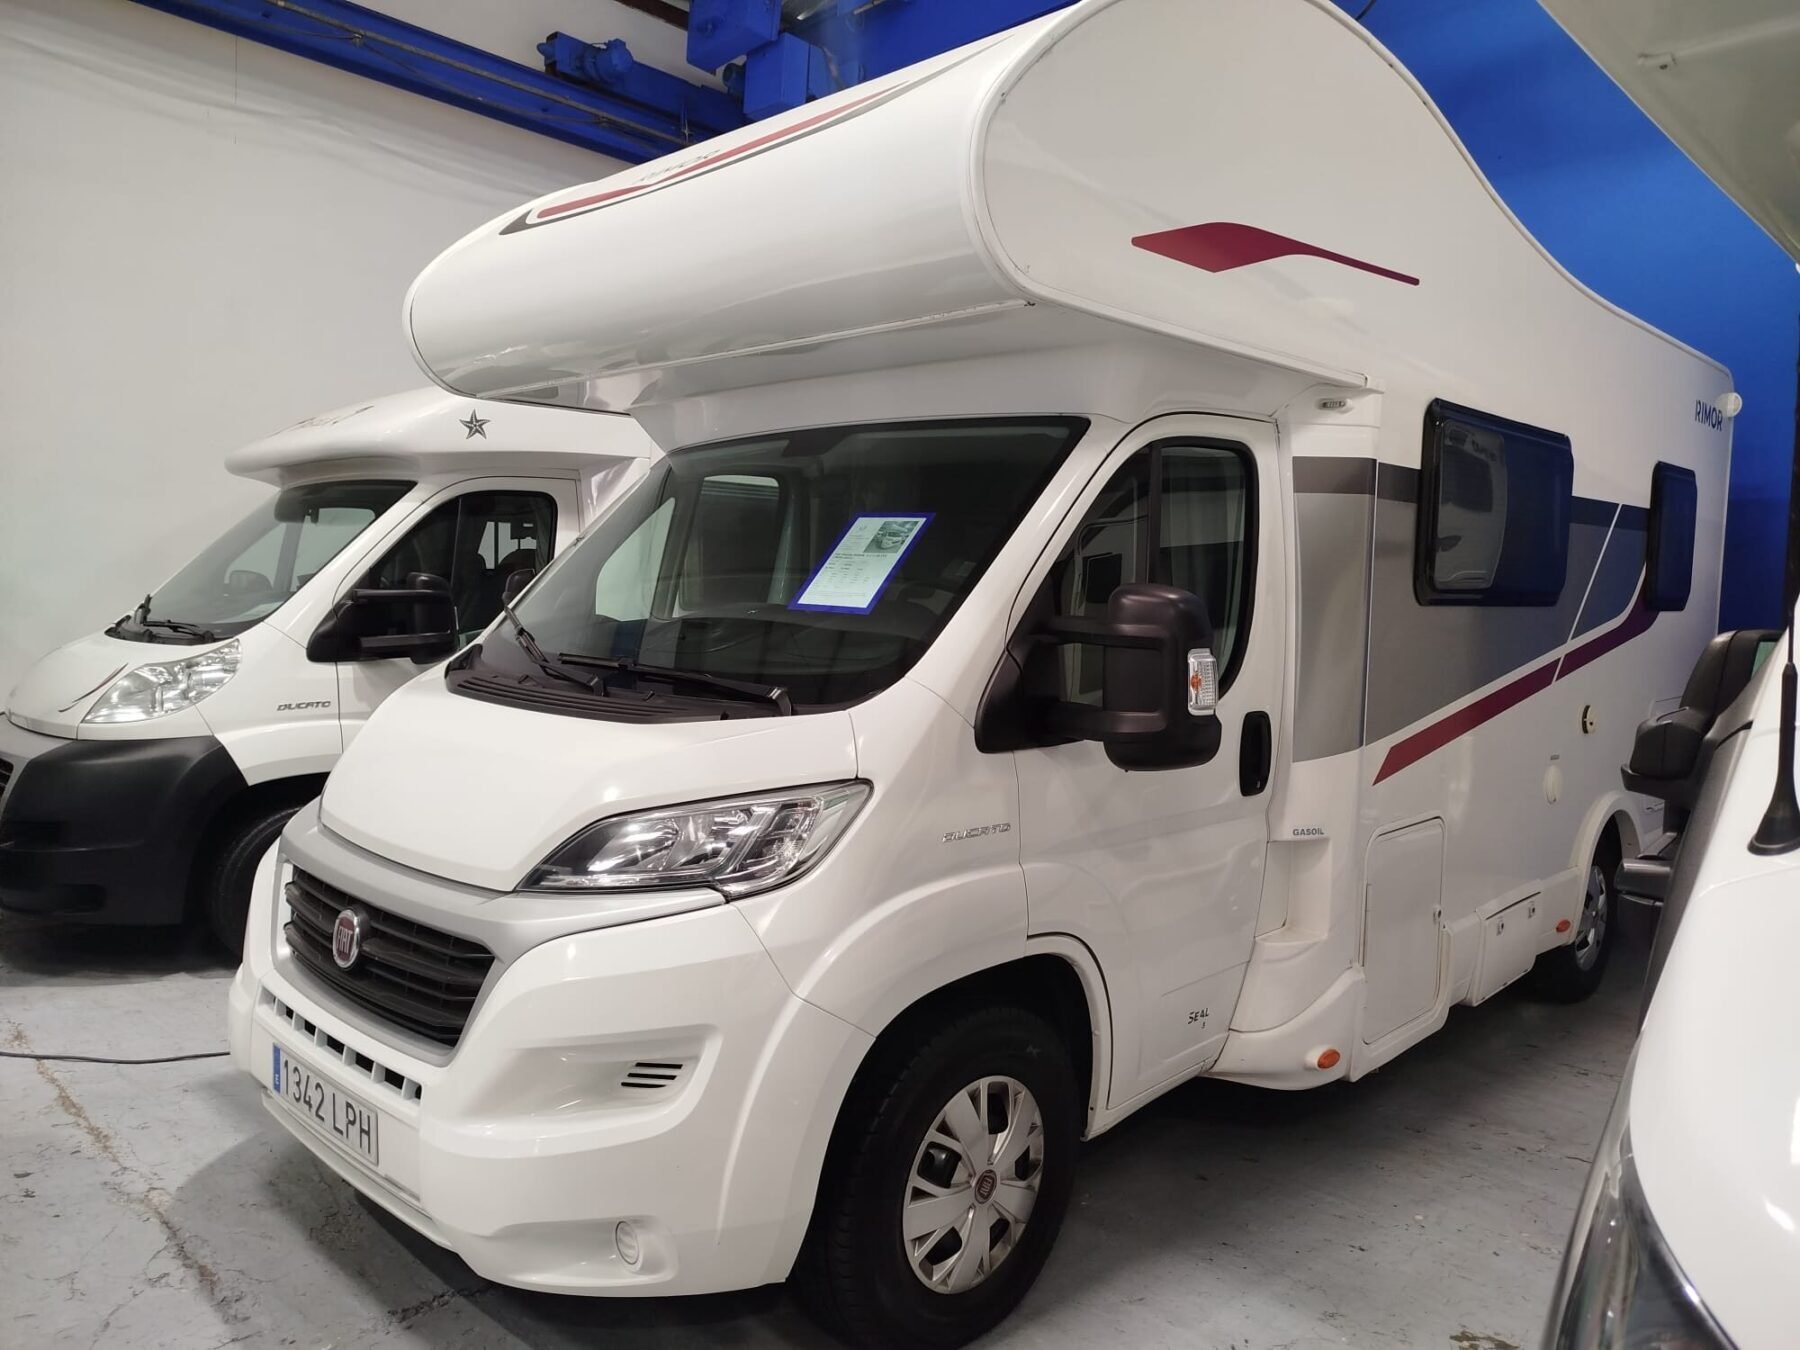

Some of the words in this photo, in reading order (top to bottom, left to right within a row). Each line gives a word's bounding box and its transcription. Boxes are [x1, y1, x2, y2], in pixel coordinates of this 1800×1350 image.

[1694, 399, 1723, 432] RIMOR
[276, 700, 331, 711] DUCATO
[942, 822, 1011, 842] DUCATO
[1292, 827, 1325, 836] GASOIL
[336, 925, 354, 954] FIAT
[284, 1059, 325, 1122] 1342
[332, 1092, 371, 1154] LPH
